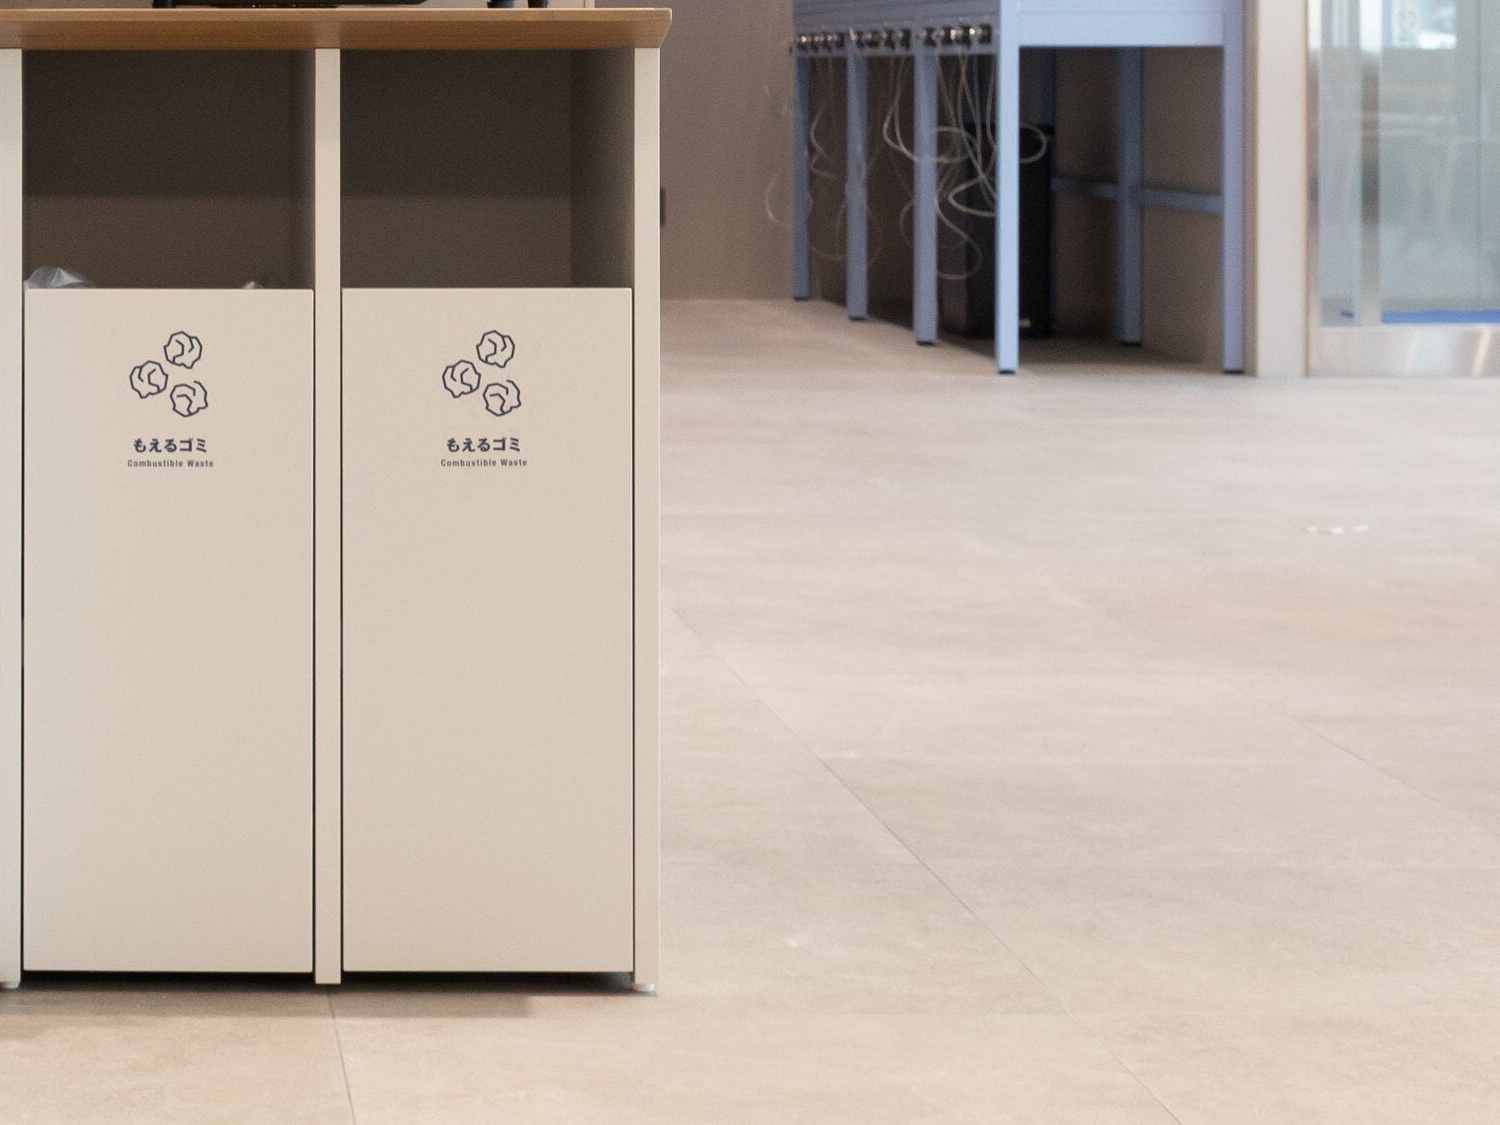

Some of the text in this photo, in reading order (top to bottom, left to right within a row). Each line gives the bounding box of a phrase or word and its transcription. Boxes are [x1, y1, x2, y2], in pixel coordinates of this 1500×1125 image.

[133, 438, 207, 453] もえるゴミ
[446, 437, 520, 452] もえるゴミ
[127, 459, 214, 467] Combustible Waste
[440, 458, 527, 467] Combustible Waste
